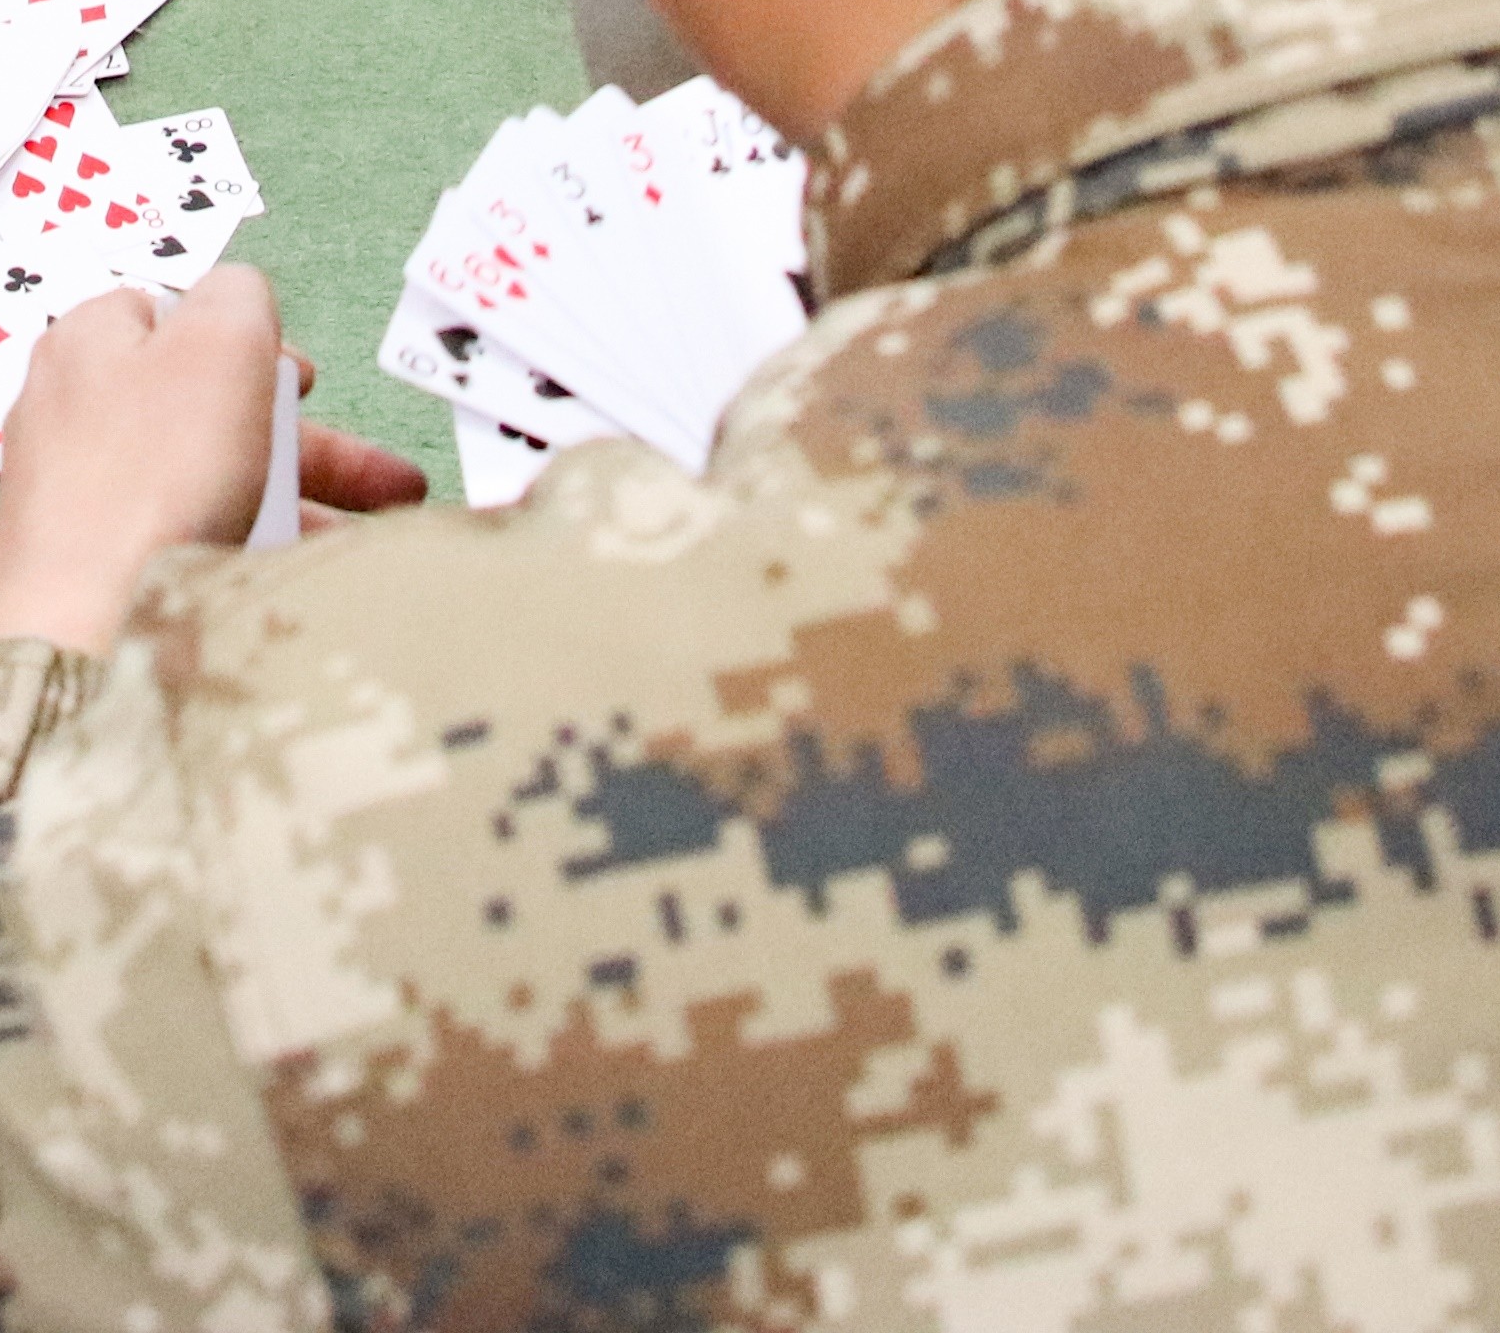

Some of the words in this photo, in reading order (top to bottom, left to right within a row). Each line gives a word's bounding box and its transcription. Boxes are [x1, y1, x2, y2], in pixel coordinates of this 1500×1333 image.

[185, 118, 213, 132] 8
[622, 133, 654, 173] 3
[214, 180, 242, 194] 8
[552, 162, 586, 201] 3
[142, 208, 164, 228] 8
[489, 198, 526, 235] 3
[463, 252, 499, 286] 6
